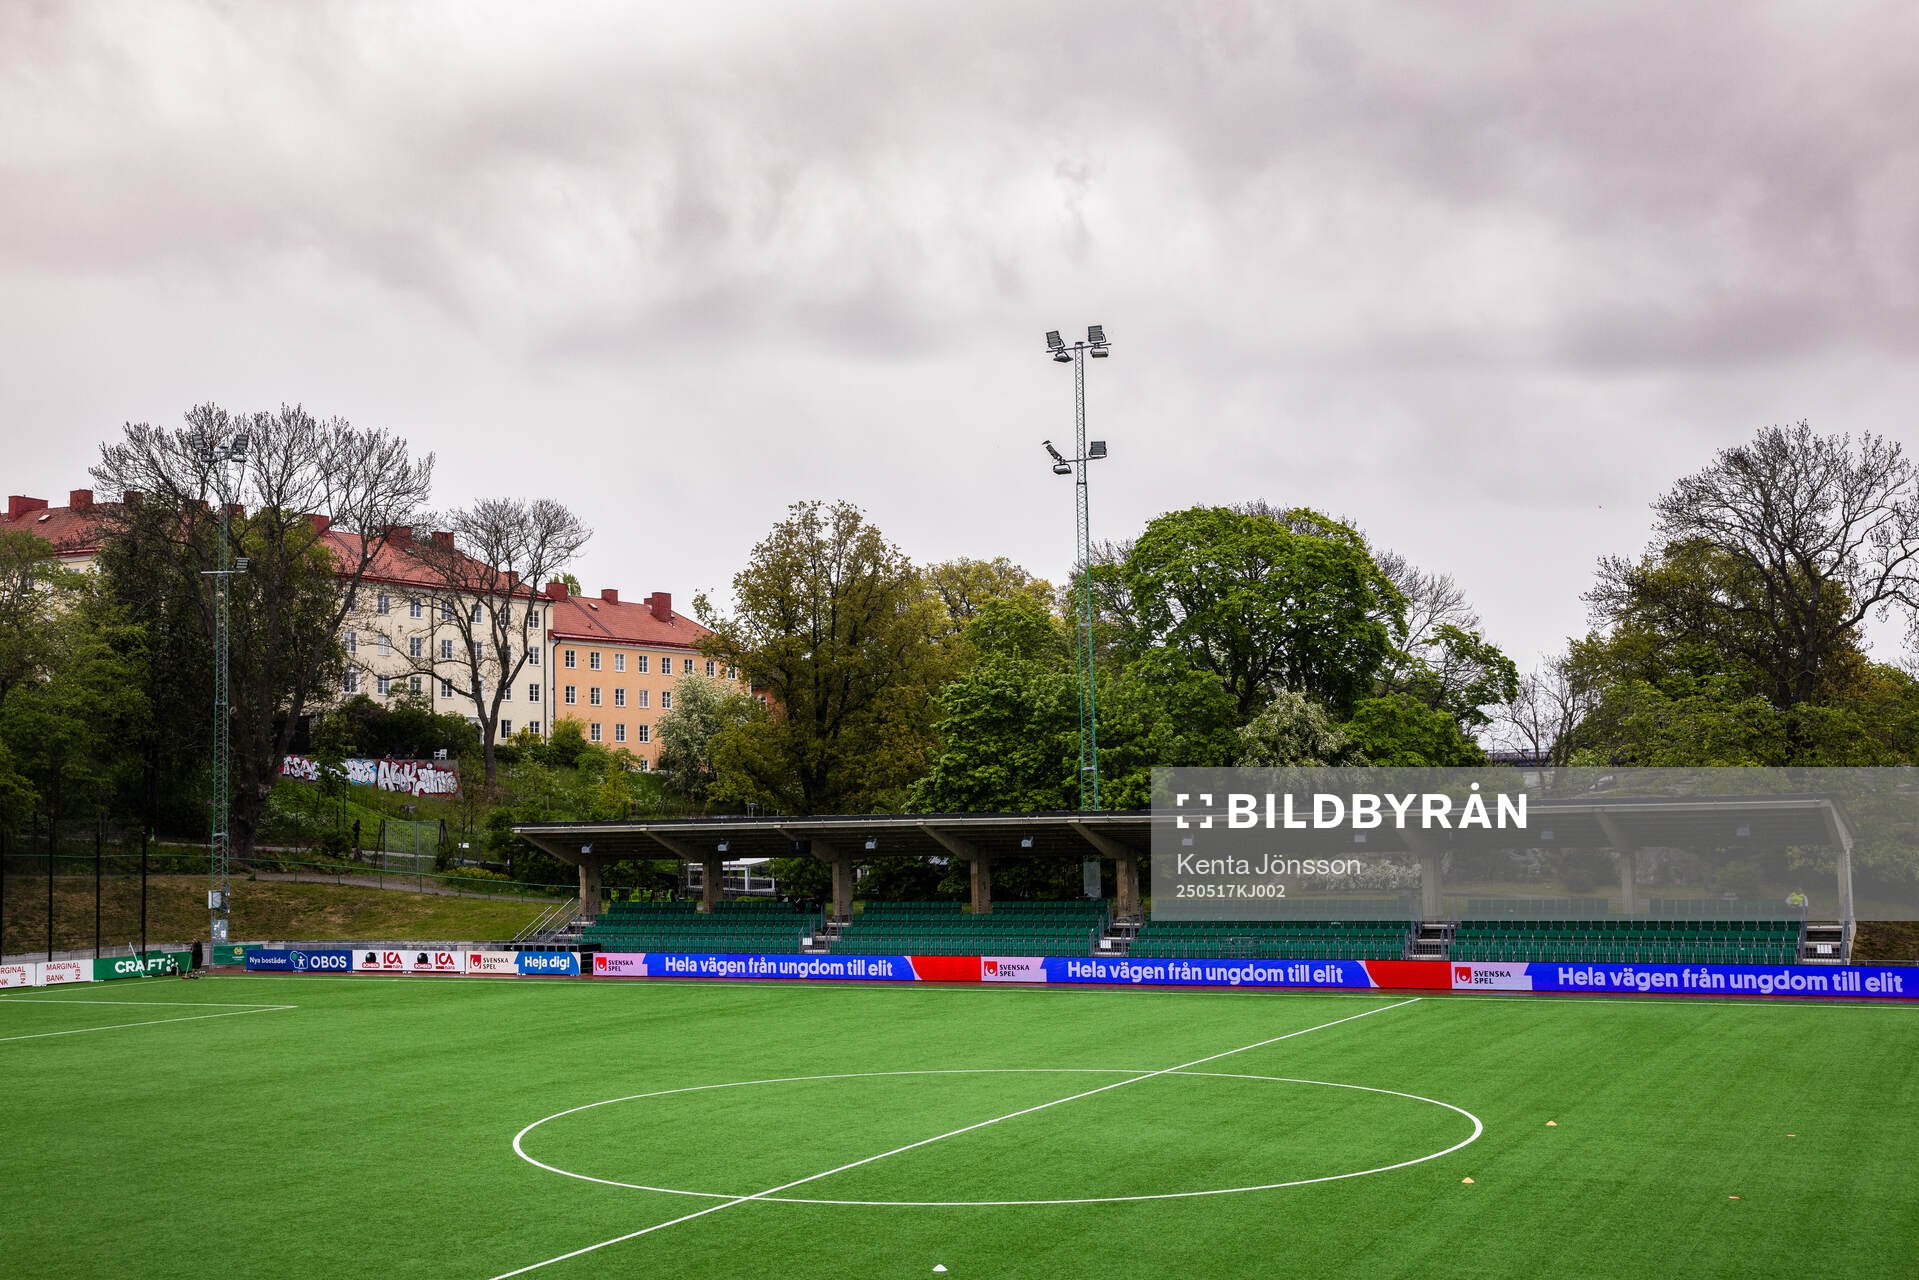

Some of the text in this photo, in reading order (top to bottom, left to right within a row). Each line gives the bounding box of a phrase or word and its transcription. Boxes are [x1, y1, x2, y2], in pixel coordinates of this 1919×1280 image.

[249, 956, 261, 965] Nya
[261, 956, 287, 965] bostäder
[310, 955, 347, 969] OBOS
[383, 951, 403, 965] ICA
[435, 952, 455, 966] ICA
[524, 956, 571, 971] Heja dig!
[0, 966, 26, 975] RGINAL
[46, 962, 80, 970] MARGINAL
[115, 958, 166, 973] CRAFT
[665, 957, 893, 978] Hela vägen från ungdom till elit
[46, 974, 64, 982] BANK
[1068, 961, 1344, 985] Hela vägen från ungdom till elit
[1474, 970, 1512, 978] SVENSKA
[1558, 967, 1903, 994] Hela vägen från ungdom till elit
